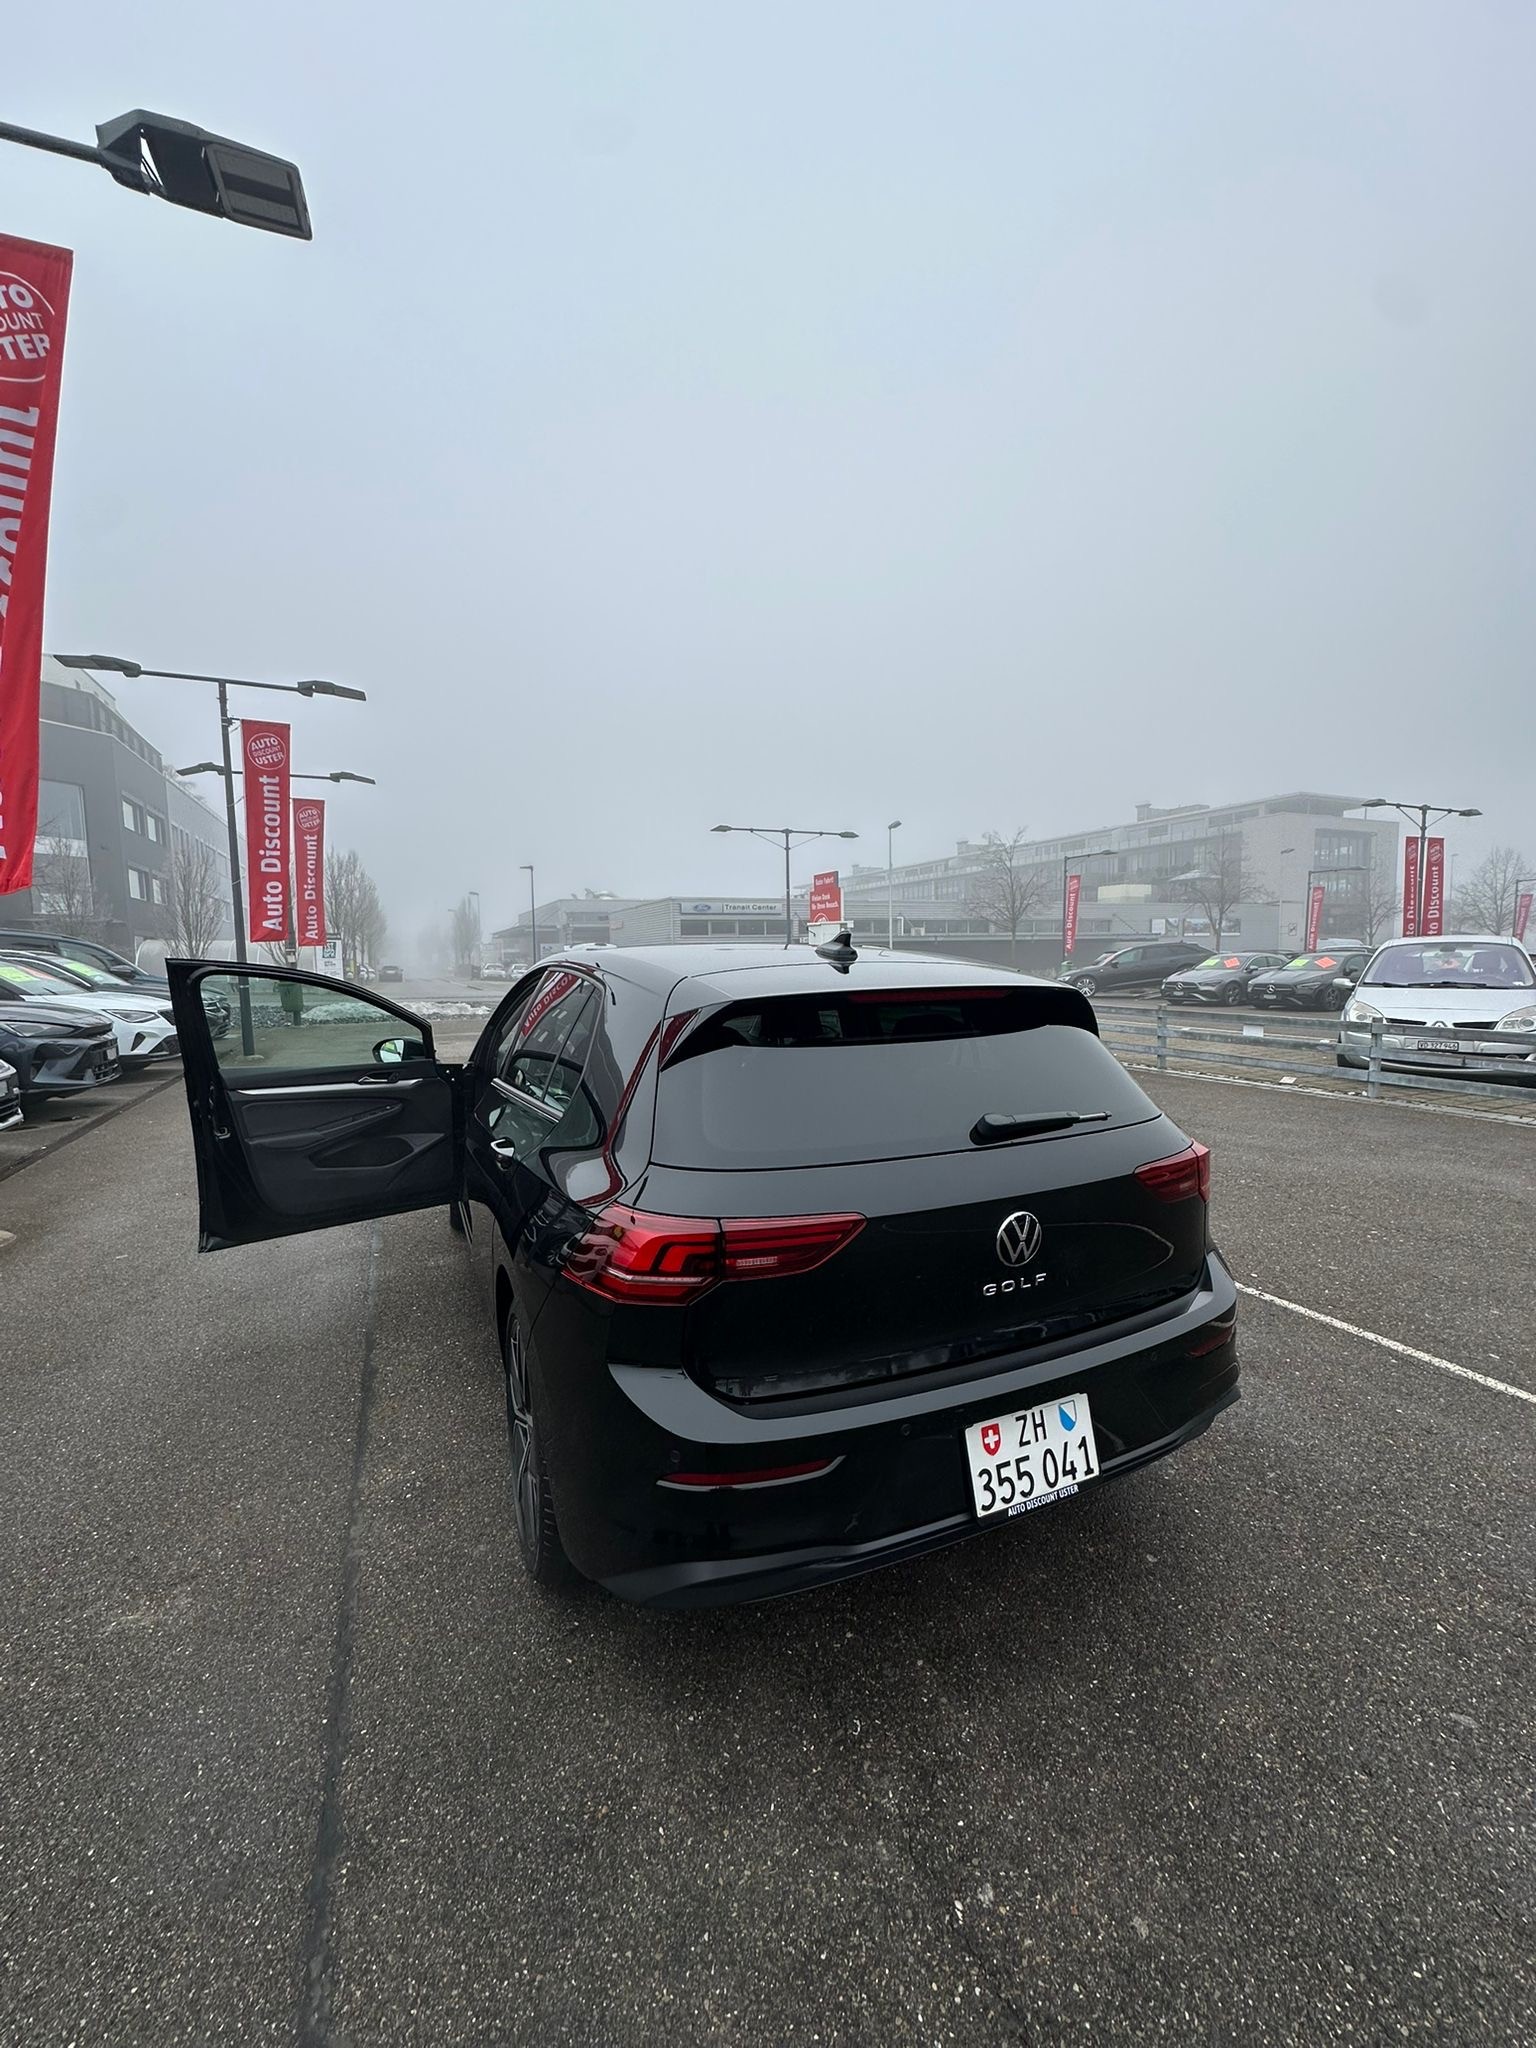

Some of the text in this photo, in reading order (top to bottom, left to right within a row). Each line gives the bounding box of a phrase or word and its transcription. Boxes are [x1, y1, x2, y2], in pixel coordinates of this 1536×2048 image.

[0, 333, 51, 361] TER
[251, 737, 279, 751] AUTO
[252, 745, 281, 757] DISCOUNT
[255, 751, 284, 765] USTER
[259, 775, 283, 931] Auto Discount
[303, 834, 319, 900] Discount
[724, 903, 777, 911] Transit Center
[1427, 865, 1440, 919] Discount
[305, 905, 319, 940] Auto
[1066, 893, 1076, 928] Discount
[983, 1273, 1047, 1296] GOLF
[1015, 1409, 1047, 1448] ZH
[978, 1435, 1095, 1511] 355 041
[1008, 1484, 1080, 1517] AUTO DISCOUNT USTER
